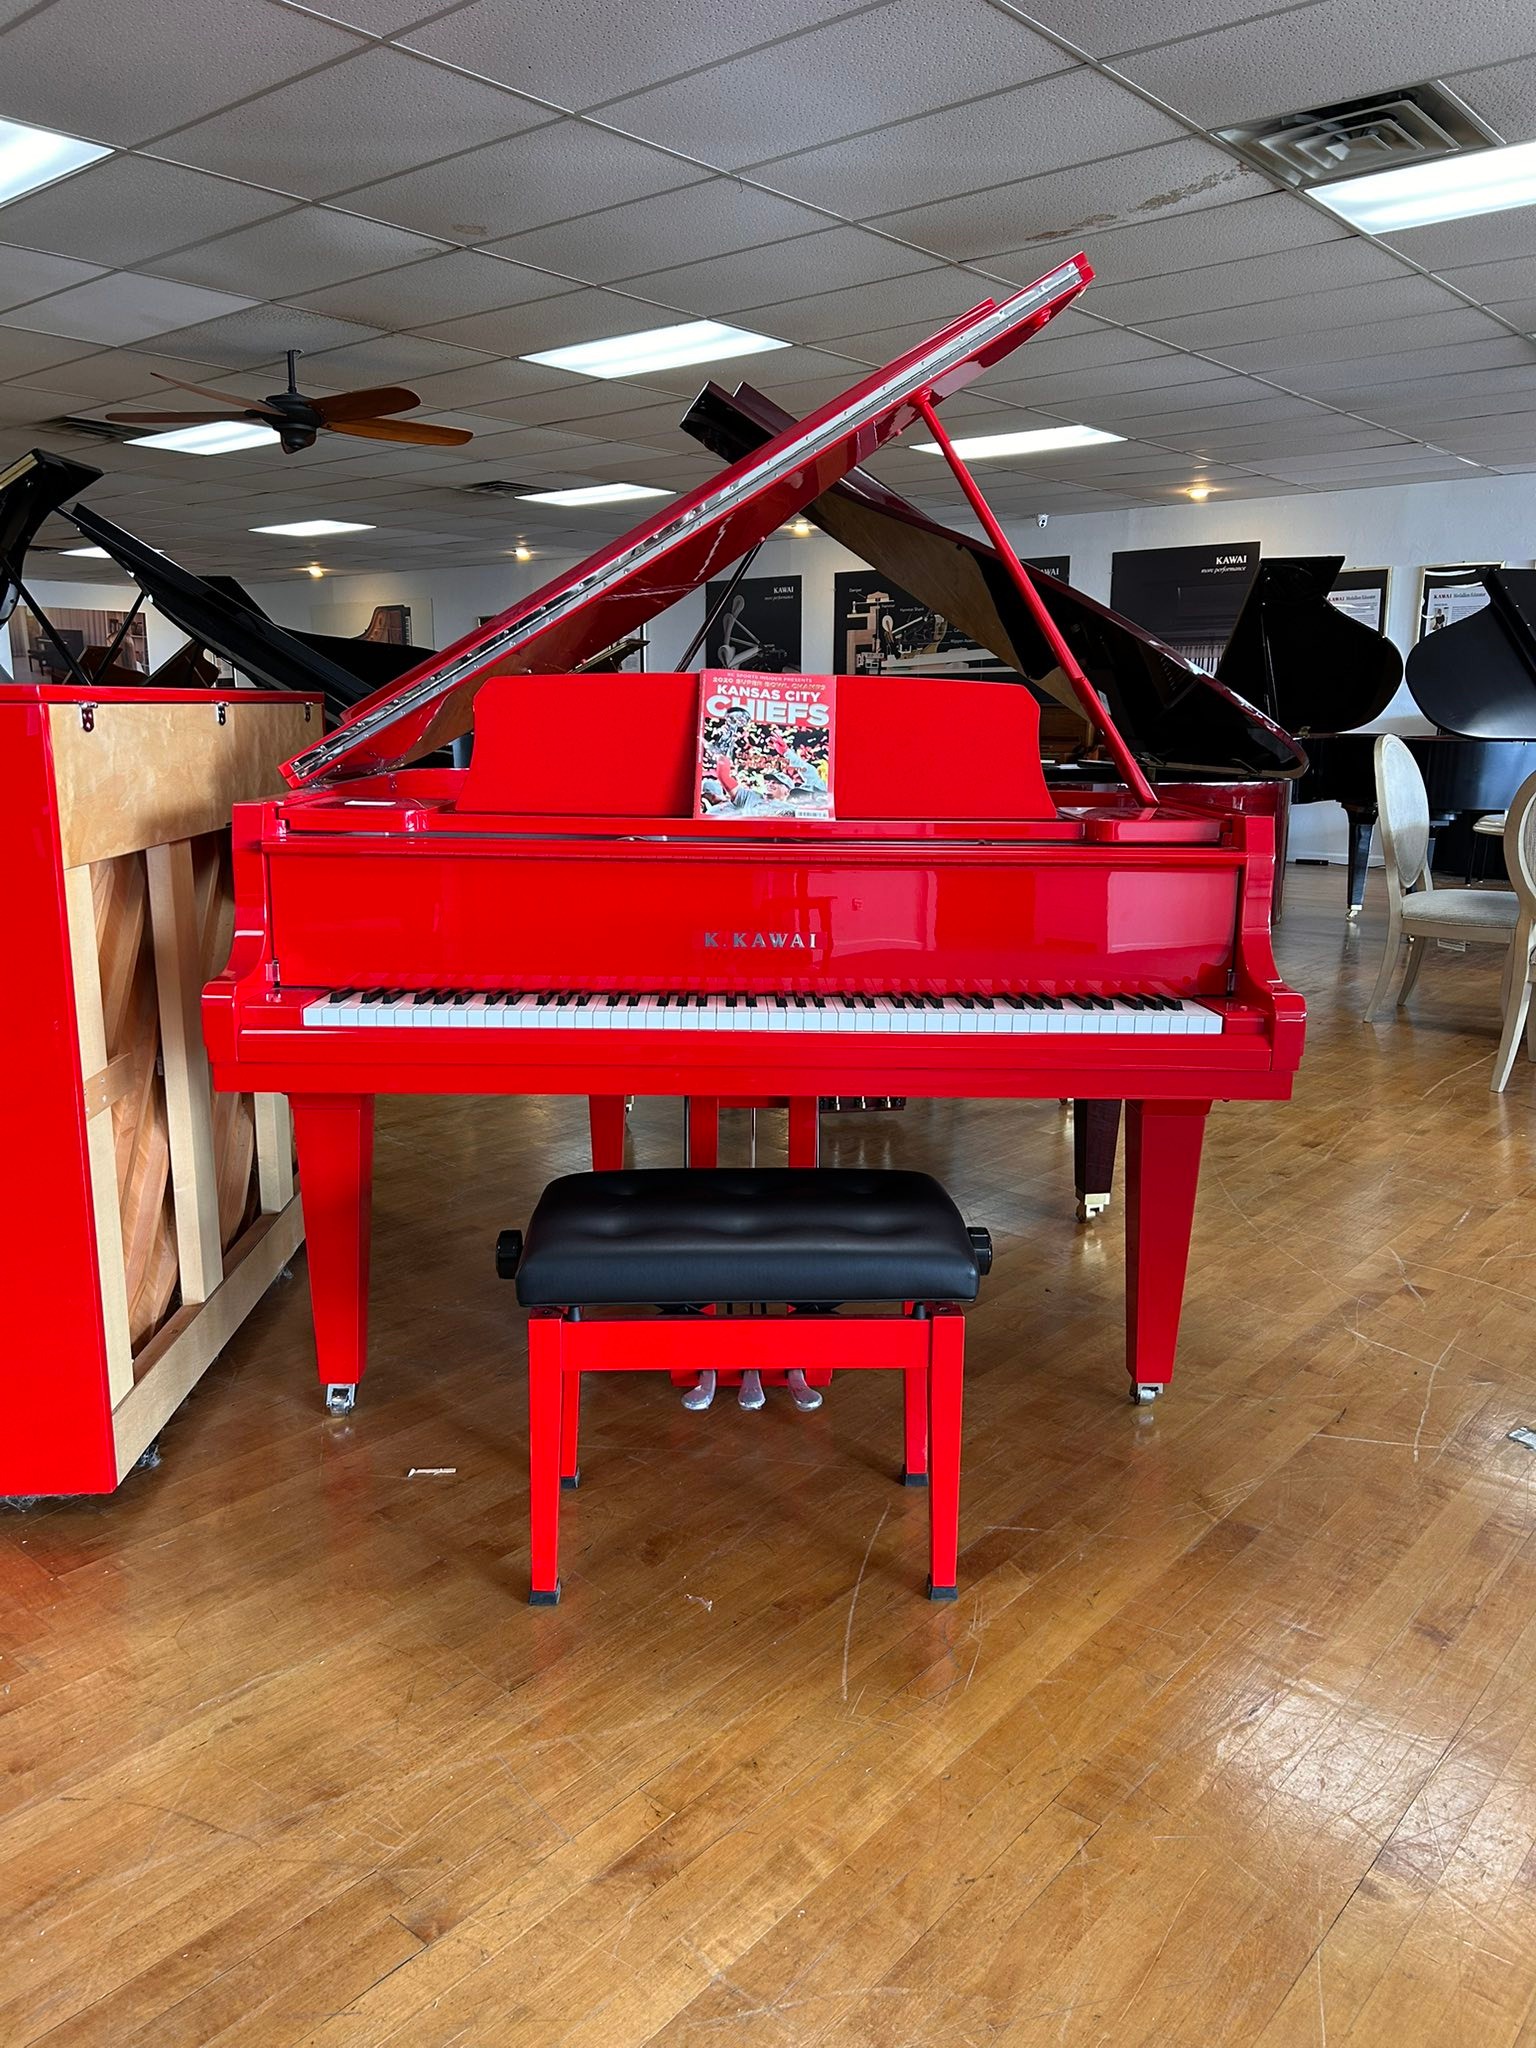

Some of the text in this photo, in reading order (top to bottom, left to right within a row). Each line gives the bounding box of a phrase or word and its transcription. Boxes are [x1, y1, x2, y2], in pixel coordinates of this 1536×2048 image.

[1216, 555, 1247, 565] KAWAI
[773, 586, 793, 594] KAWAI
[735, 678, 763, 687] SUPER
[764, 681, 790, 689] BOWL
[717, 684, 821, 702] KANSAS CITY
[706, 694, 830, 726] CHIEFS
